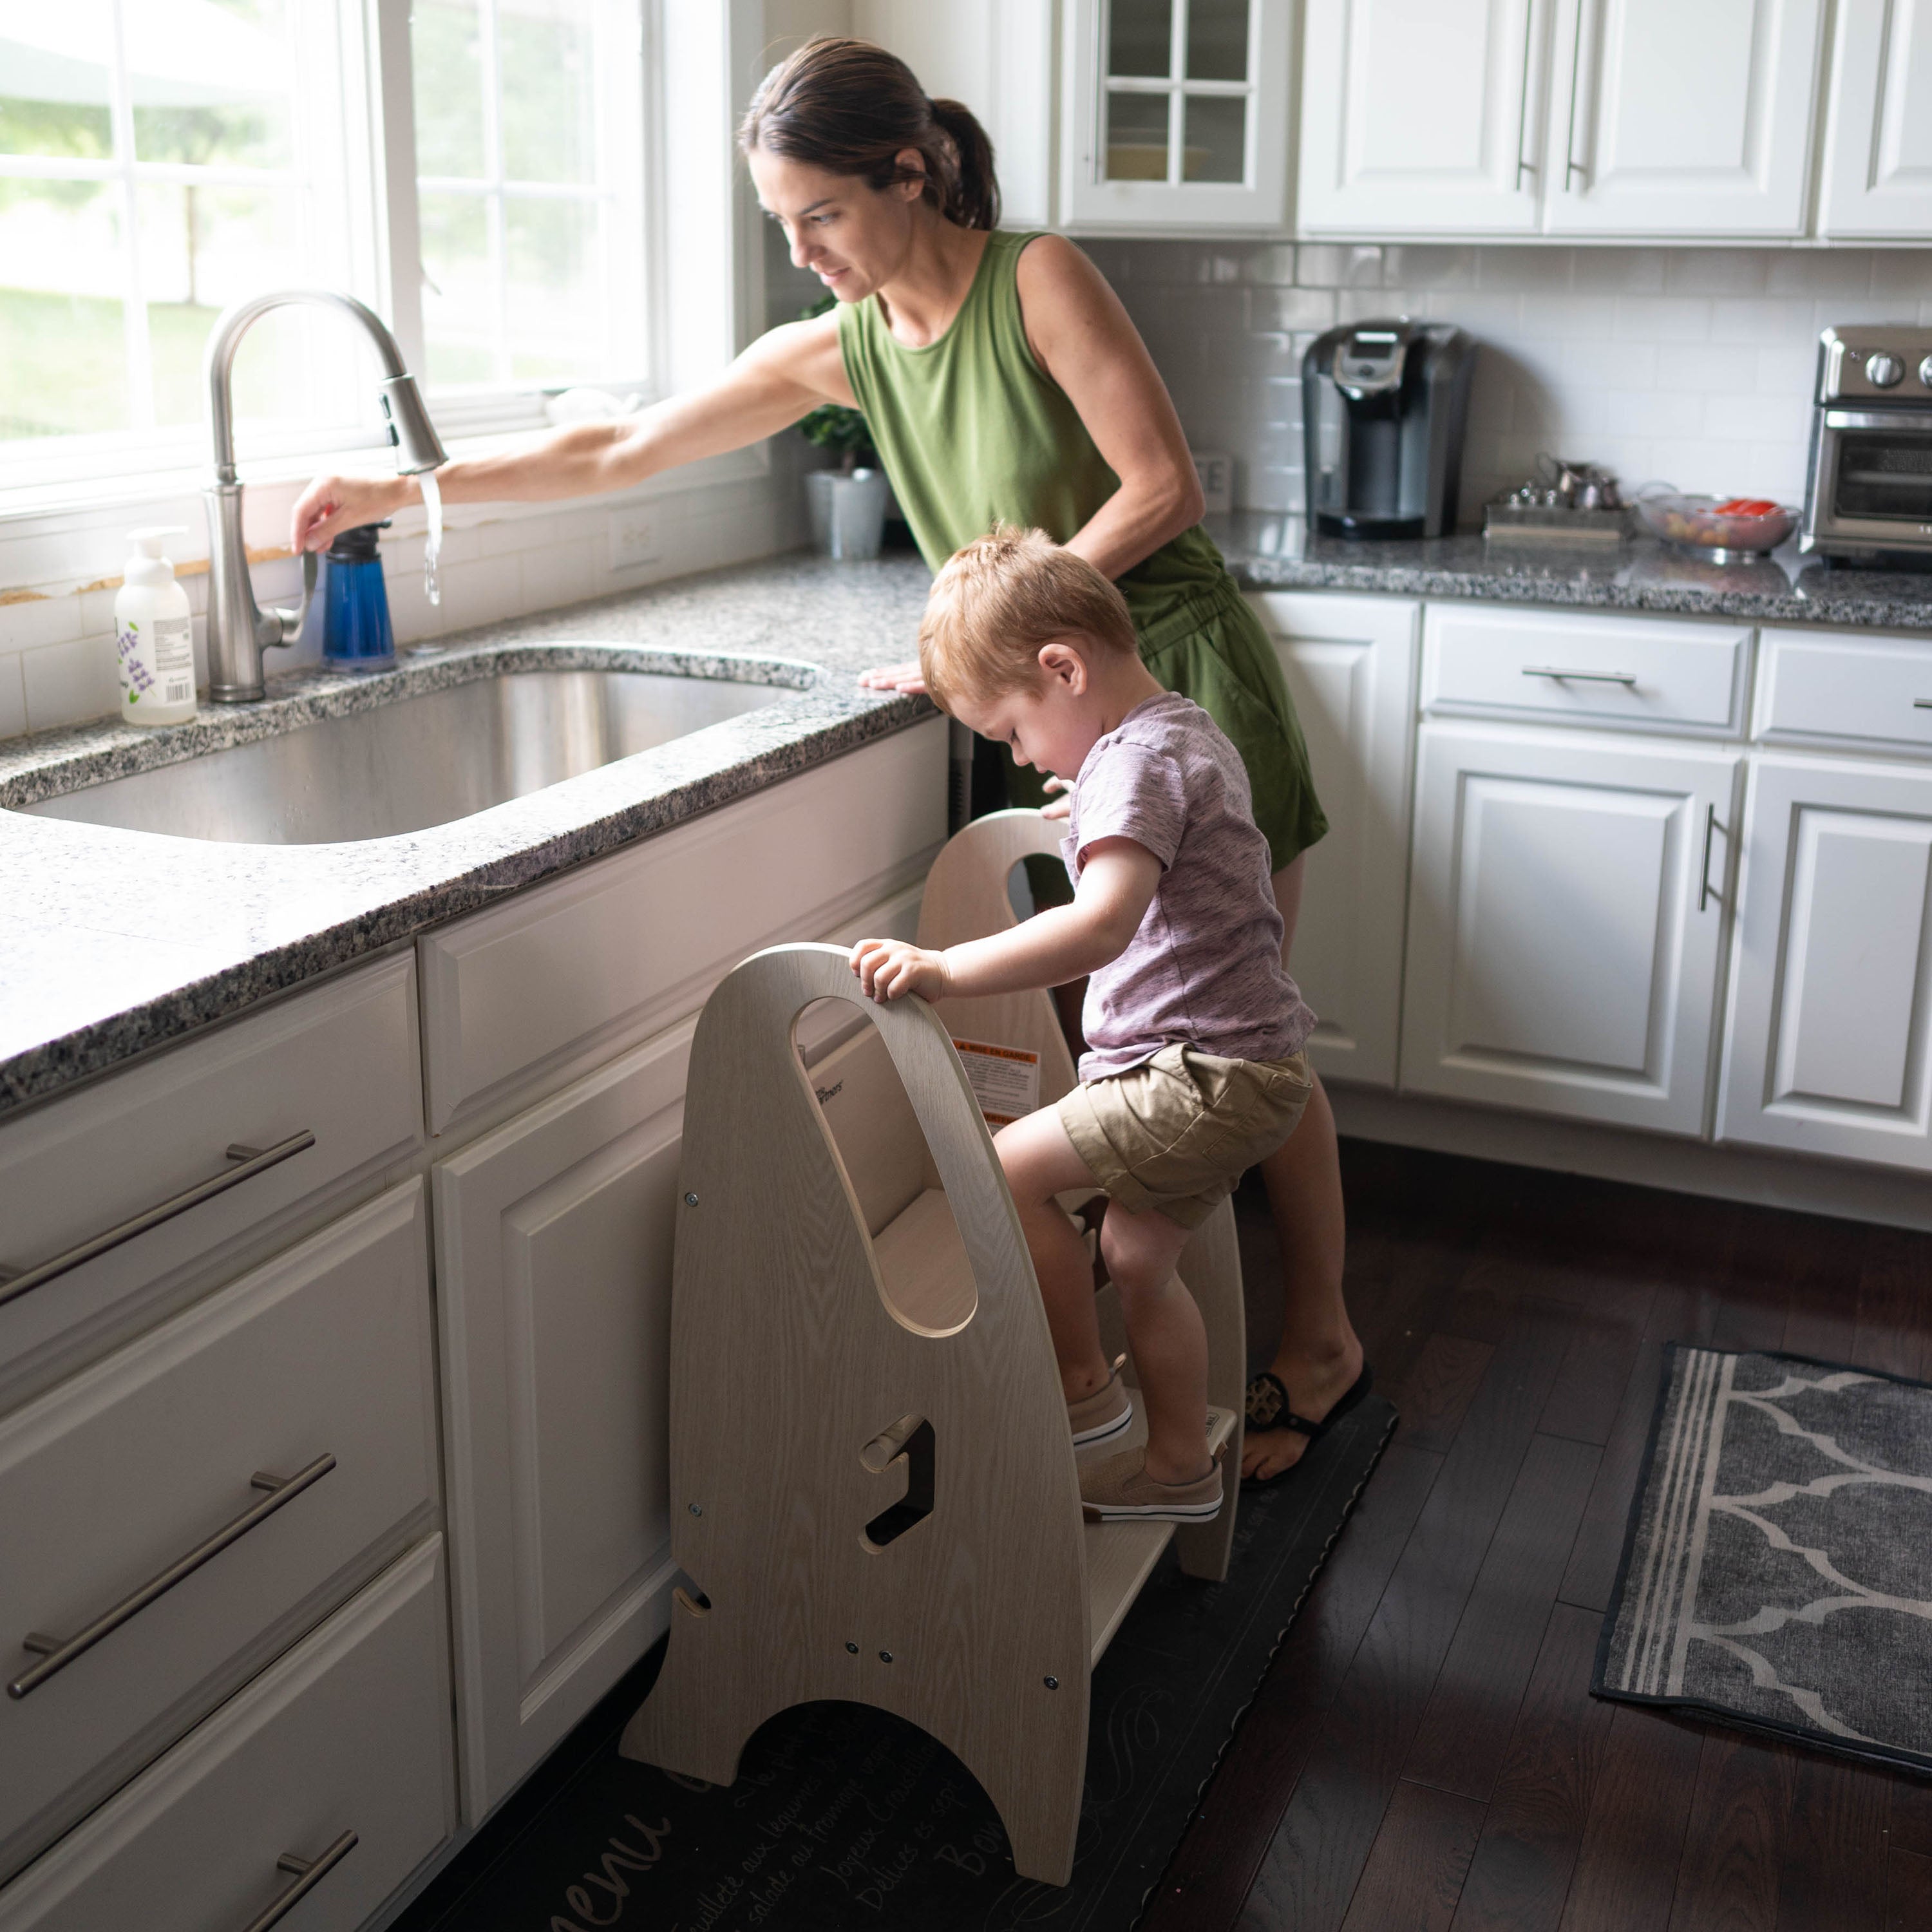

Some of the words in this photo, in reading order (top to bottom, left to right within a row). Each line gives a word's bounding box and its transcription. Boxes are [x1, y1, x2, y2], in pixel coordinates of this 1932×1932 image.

[800, 1778, 869, 1843] fromage
[742, 1842, 779, 1873] aux
[791, 1844, 814, 1866] au
[819, 1828, 885, 1891] Joyeux
[748, 1870, 795, 1925] salade
